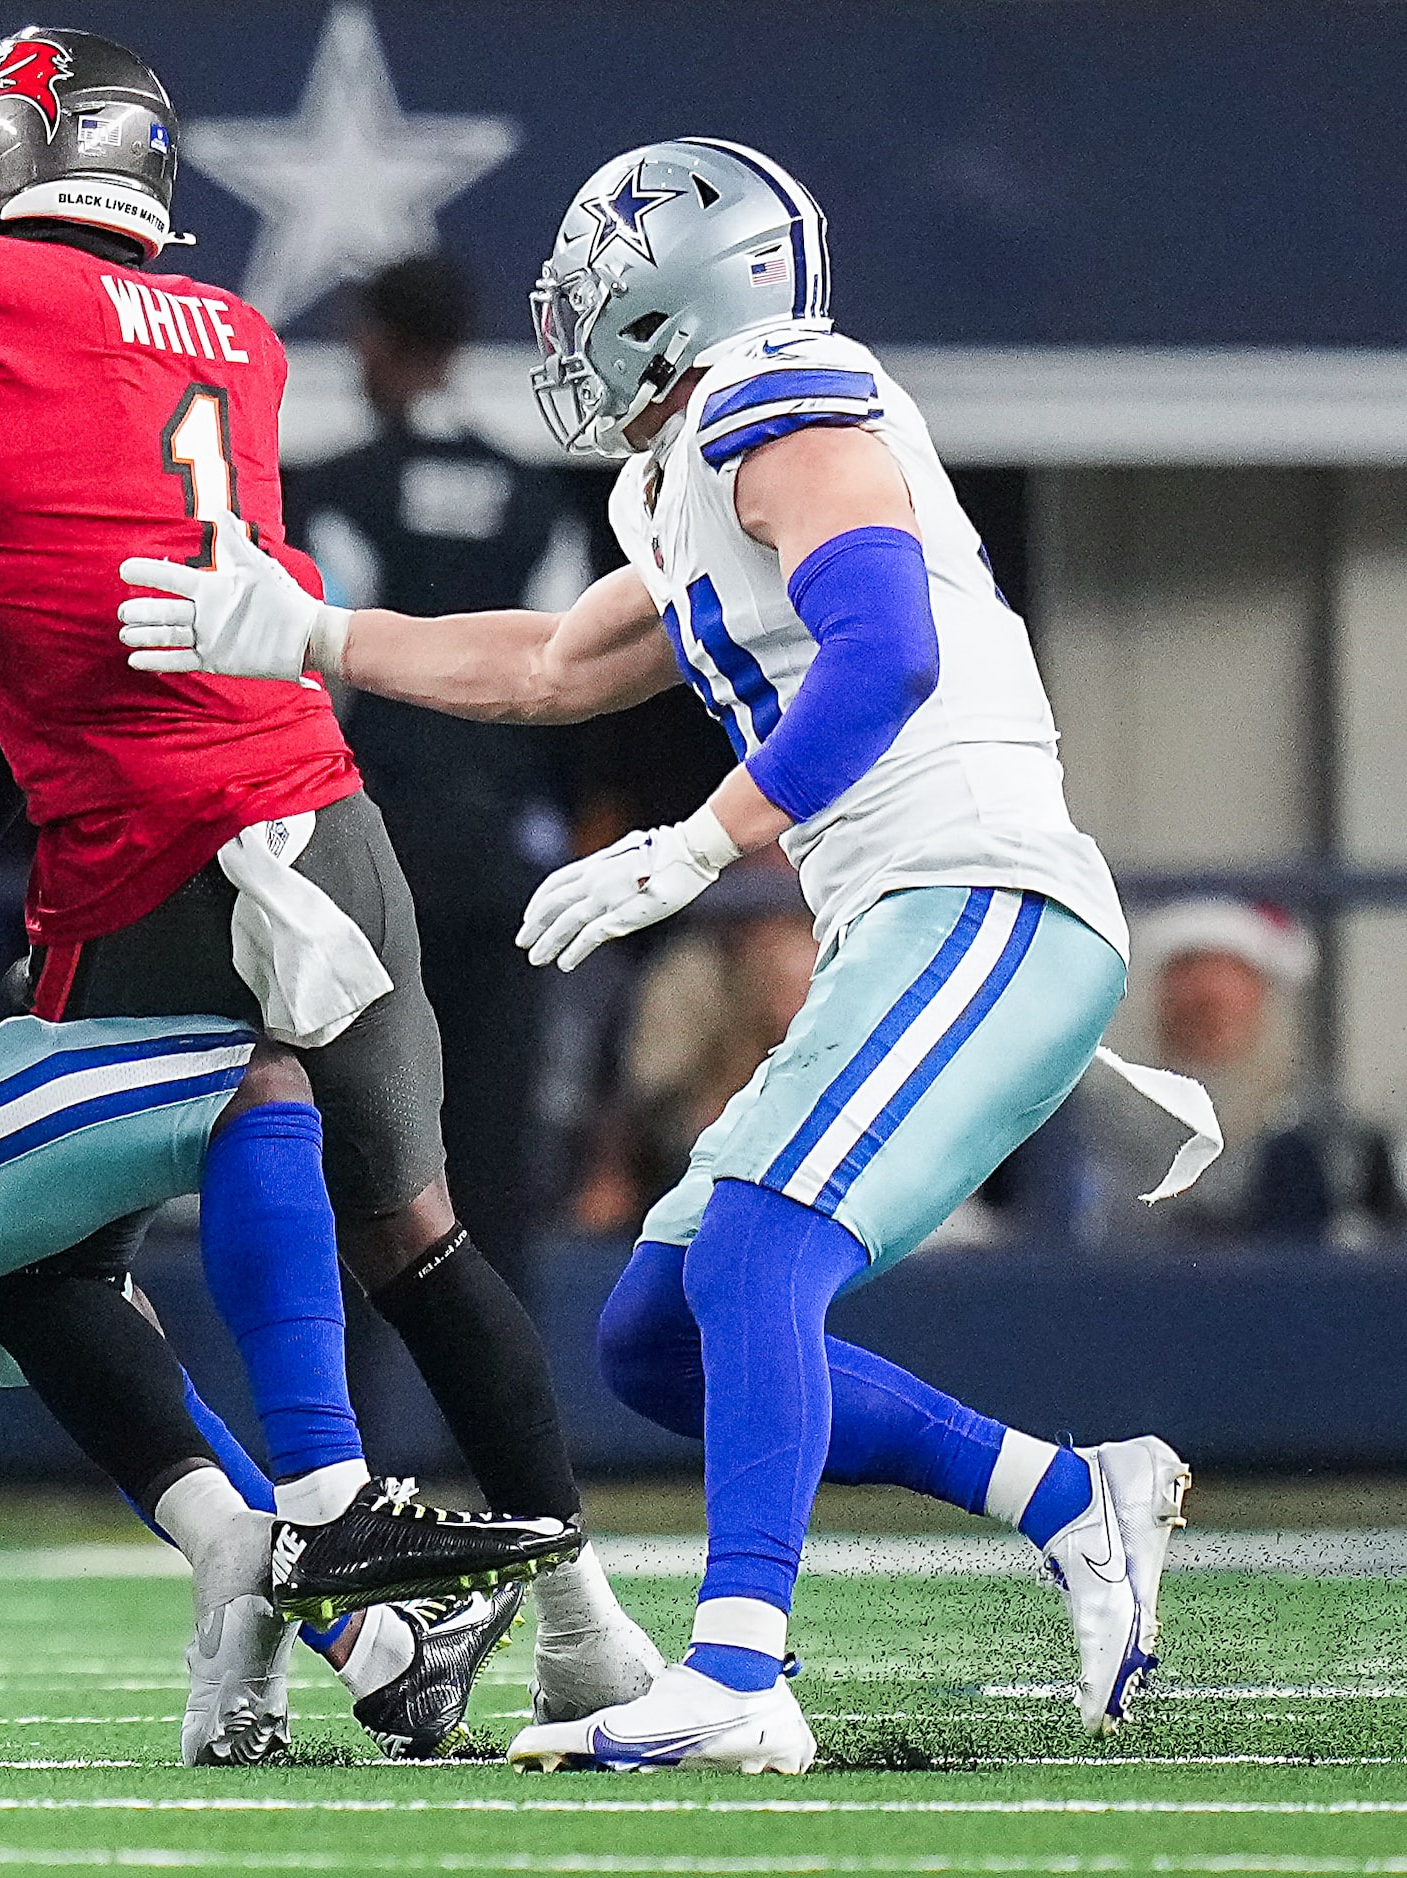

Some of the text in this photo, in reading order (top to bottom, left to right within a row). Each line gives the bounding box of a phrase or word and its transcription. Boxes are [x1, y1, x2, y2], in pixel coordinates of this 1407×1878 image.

[58, 193, 166, 233] BLACK LIVES MATTER
[100, 274, 250, 364] WHITE
[161, 382, 269, 573] 1
